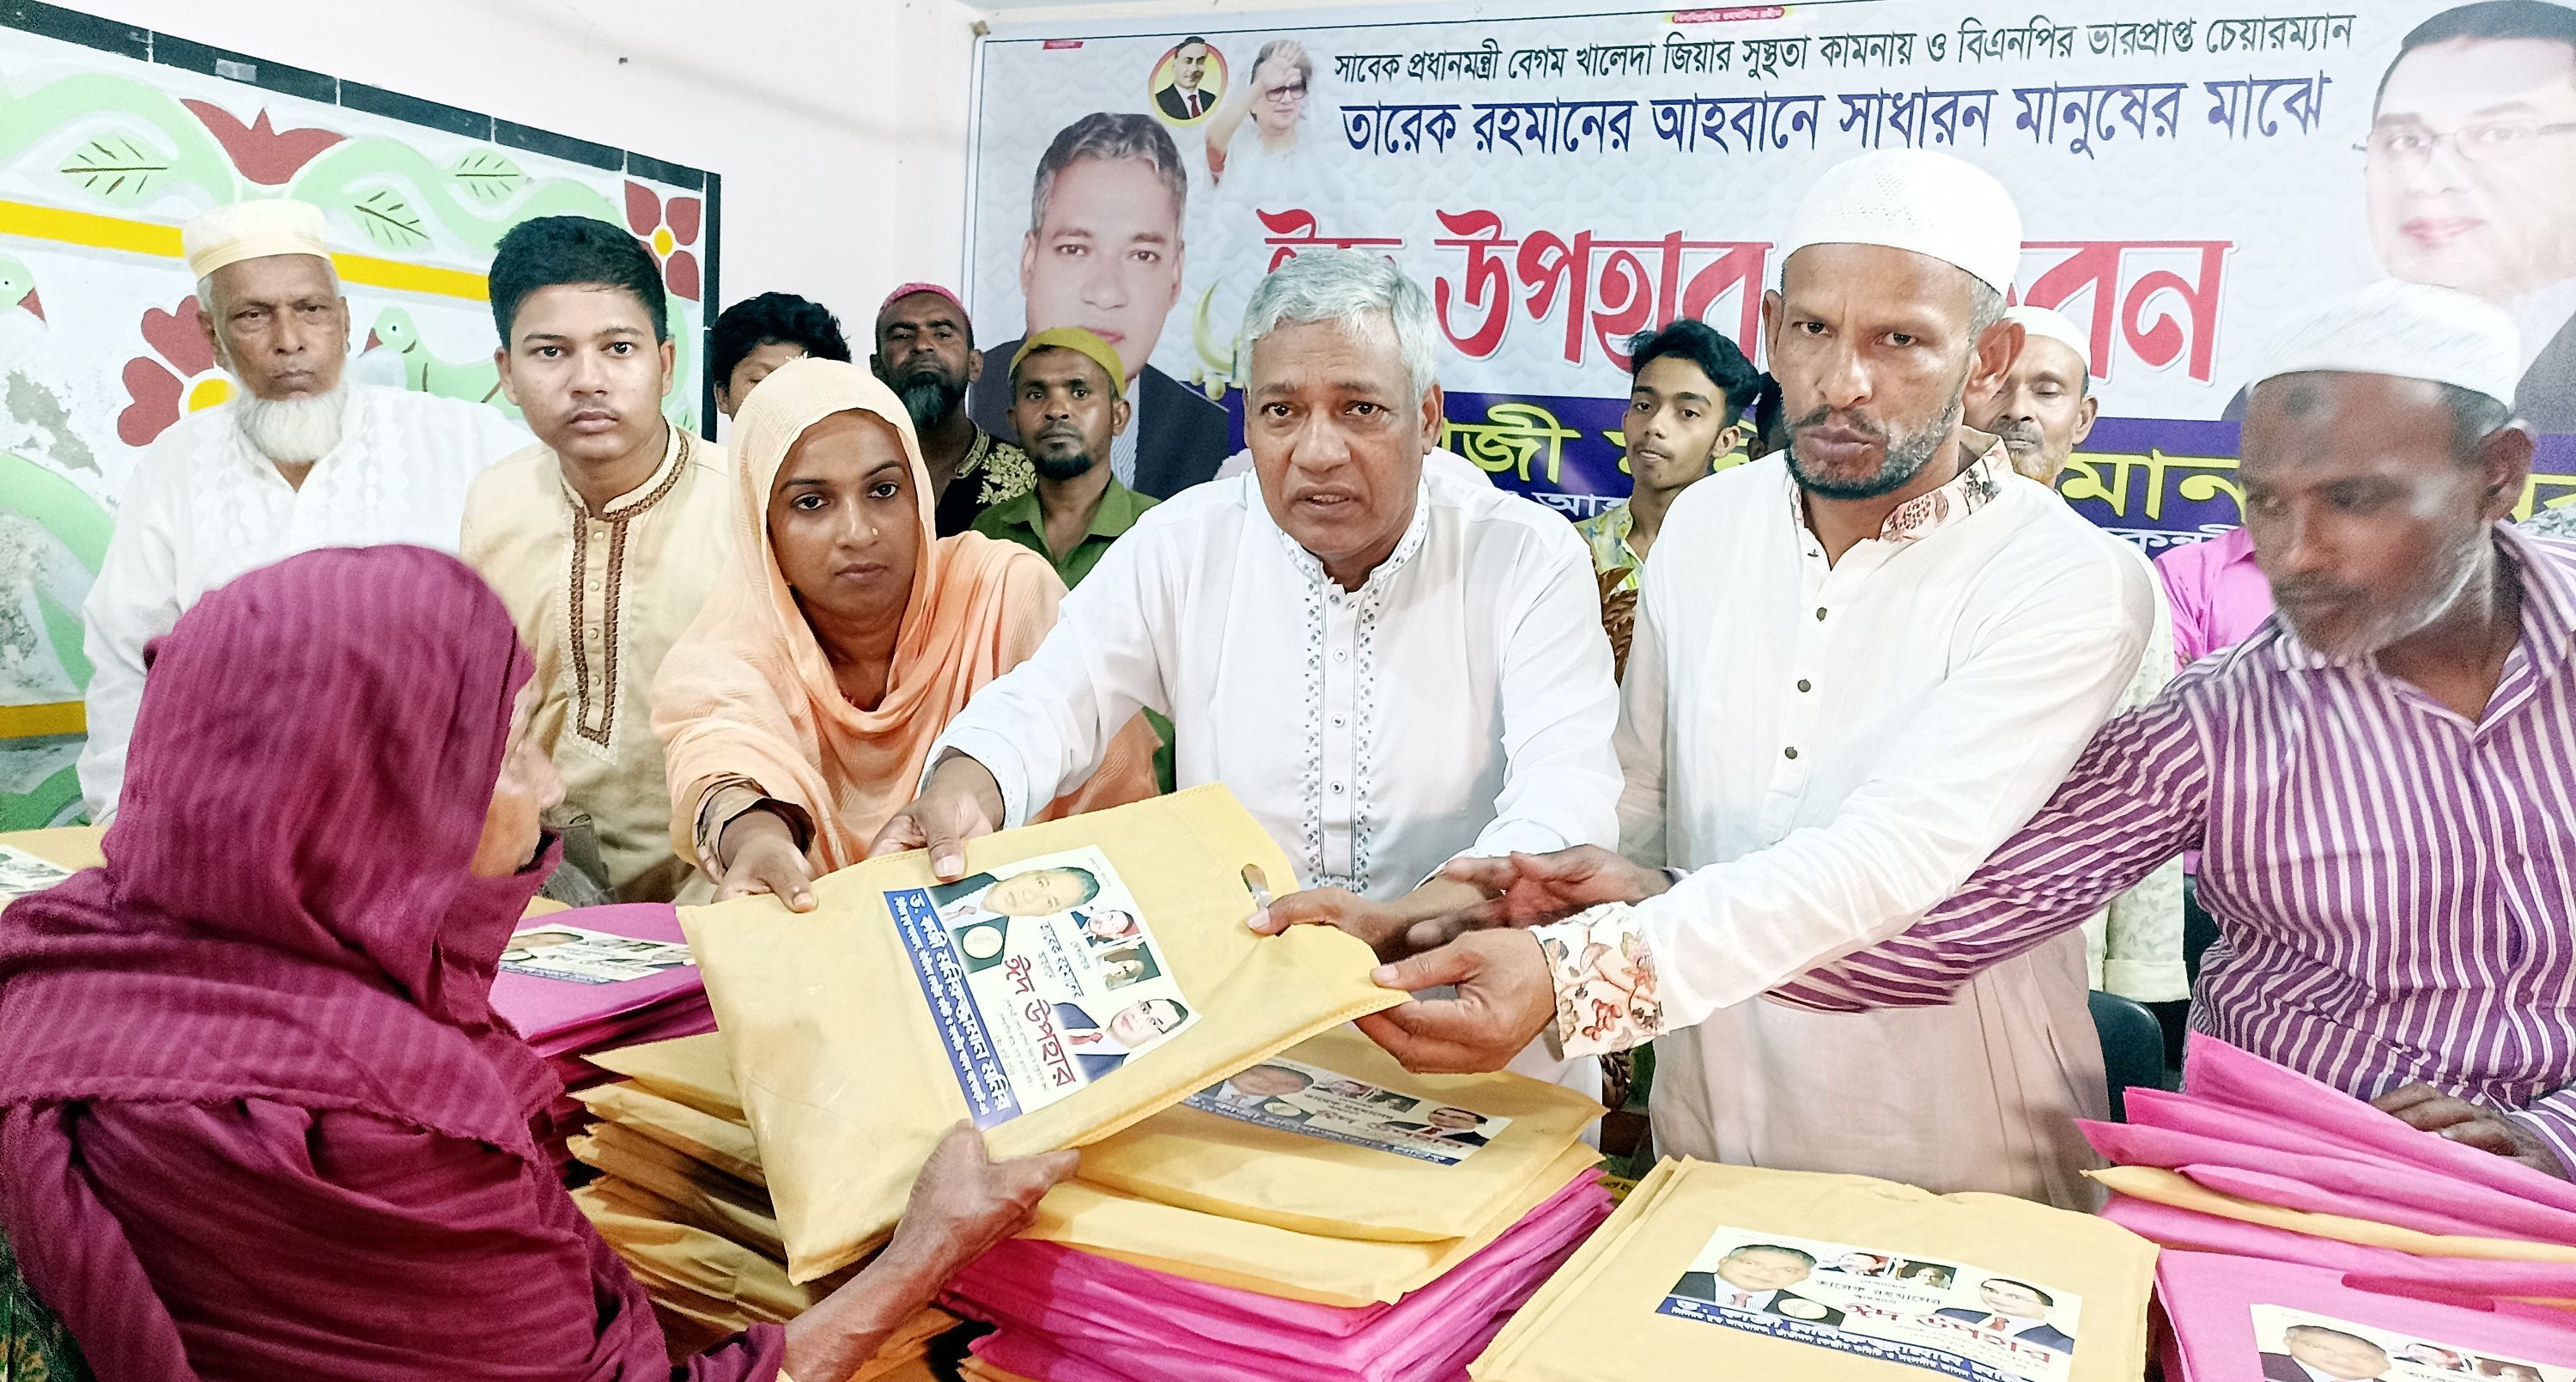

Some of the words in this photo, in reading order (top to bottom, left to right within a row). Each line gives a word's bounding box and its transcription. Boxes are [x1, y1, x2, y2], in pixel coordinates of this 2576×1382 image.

[1335, 53, 1403, 82] সাবেক
[1407, 38, 1503, 82] প্রধানমন্ত্রী
[1509, 45, 1569, 80] বেগম
[1577, 43, 1656, 76] খালেদা
[1663, 32, 1735, 74] জিয়ার
[1742, 34, 1812, 80] সুস্থতা
[1819, 32, 1917, 68] কামনায়
[1927, 33, 1947, 63] ও
[1958, 16, 2077, 64] বিএনপির
[2087, 17, 2197, 58] ভারপ্রাপ্ত
[2207, 12, 2357, 54] চেয়ারম্যান
[1340, 100, 1461, 156] তারেক
[1472, 96, 1639, 156] রহমানের
[1649, 90, 1826, 155] আহবানে
[1838, 86, 1999, 149] সাধারন
[2012, 81, 2189, 161] মানুষের
[2203, 70, 2333, 140] মাঝে
[1004, 955, 1036, 995] ঈদ
[1024, 998, 1077, 1087] উপহার
